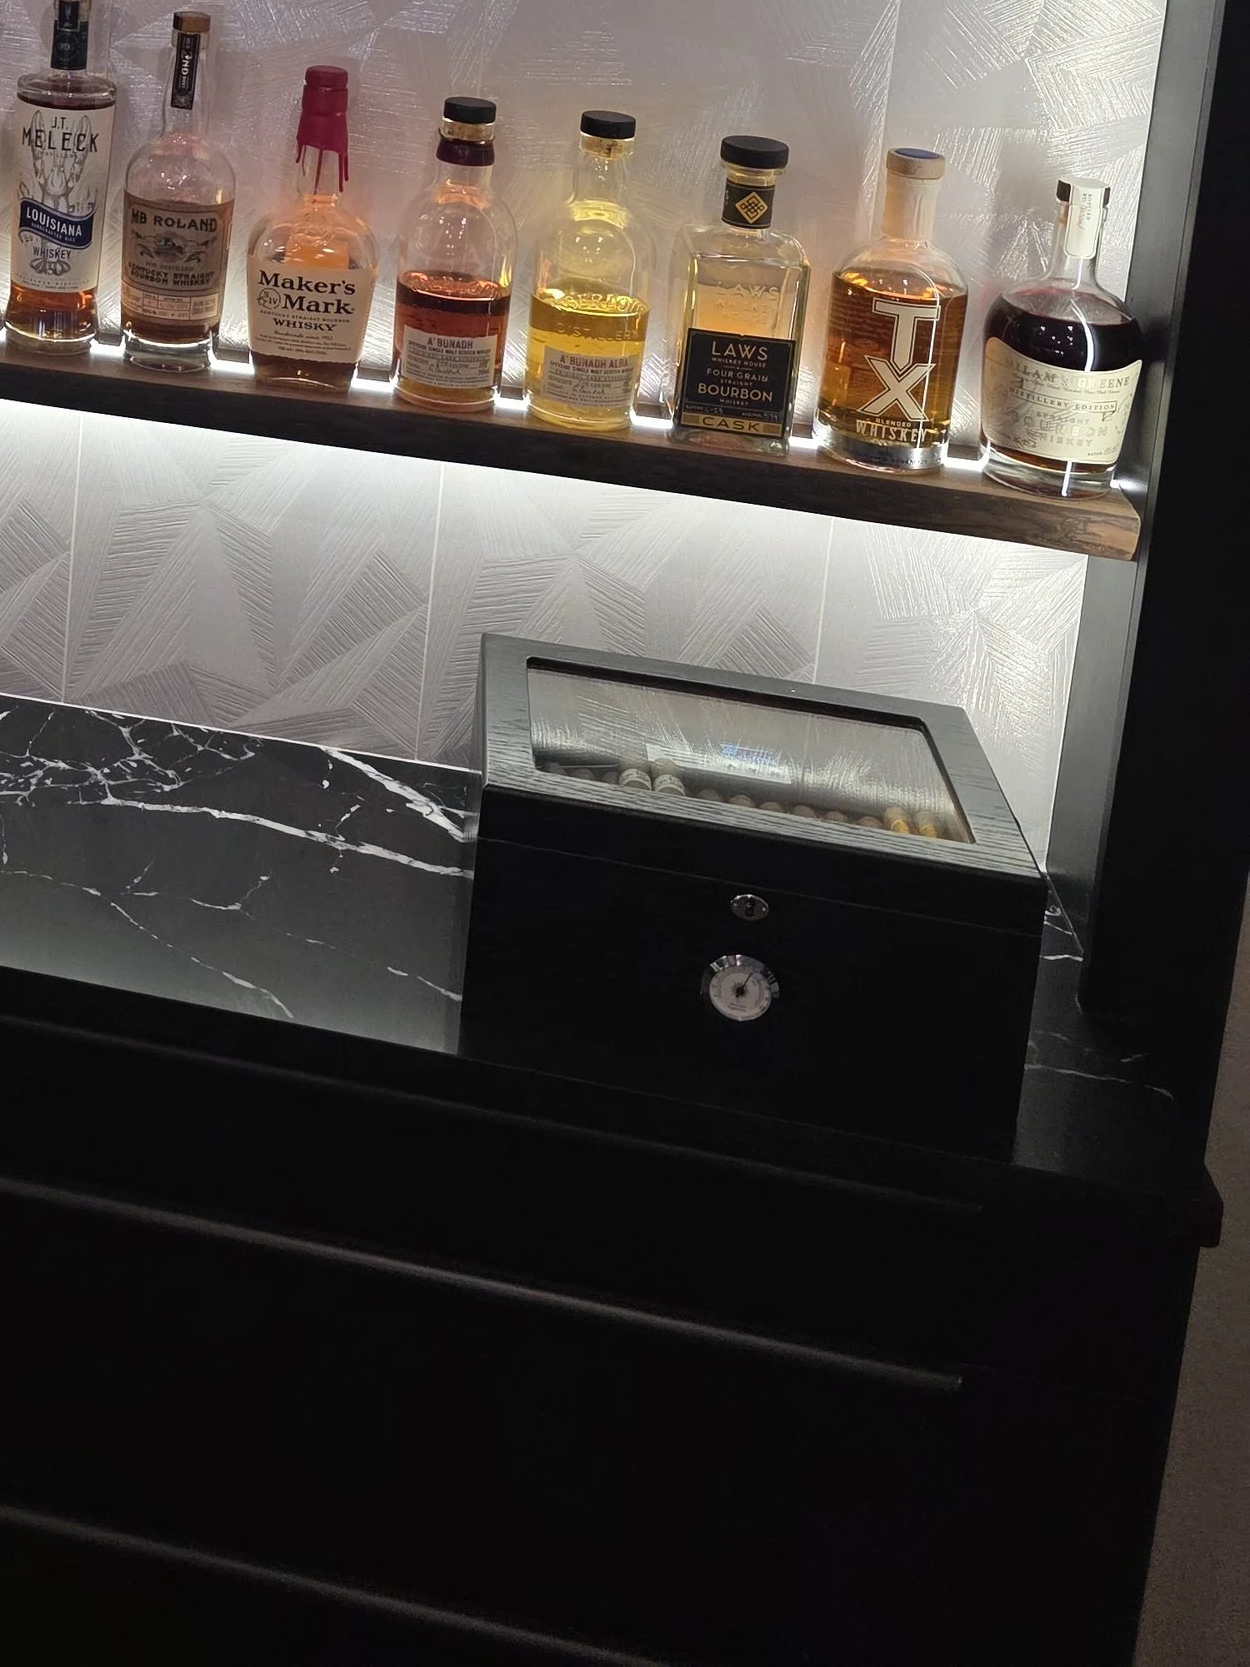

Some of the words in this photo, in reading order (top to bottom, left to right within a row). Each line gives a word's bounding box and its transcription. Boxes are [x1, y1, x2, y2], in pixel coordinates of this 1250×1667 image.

[51, 117, 68, 130] J.T.
[22, 126, 100, 153] MELECK
[26, 206, 83, 237] LOUISIANA
[131, 208, 147, 224] MB
[153, 214, 218, 233] ROLAND
[33, 245, 72, 259] WHISKEY
[128, 261, 169, 277] KENTUCKY
[173, 271, 215, 279] STRAIGHT
[131, 270, 168, 285] BOURBON
[258, 270, 356, 295] Maker's
[282, 293, 354, 315] Mark
[273, 318, 337, 332] WHISKY
[712, 341, 768, 361] LAWS
[706, 368, 733, 379] FOUR
[737, 371, 768, 382] GRAIN
[720, 378, 753, 386] STRAIGHT
[698, 382, 773, 402] BOURBON
[1009, 387, 1070, 408] DISTILLERY
[1074, 403, 1115, 411] EDITION
[702, 416, 760, 433] CASK
[856, 420, 928, 442] WHISKEY
[875, 417, 912, 428] BLENDED
